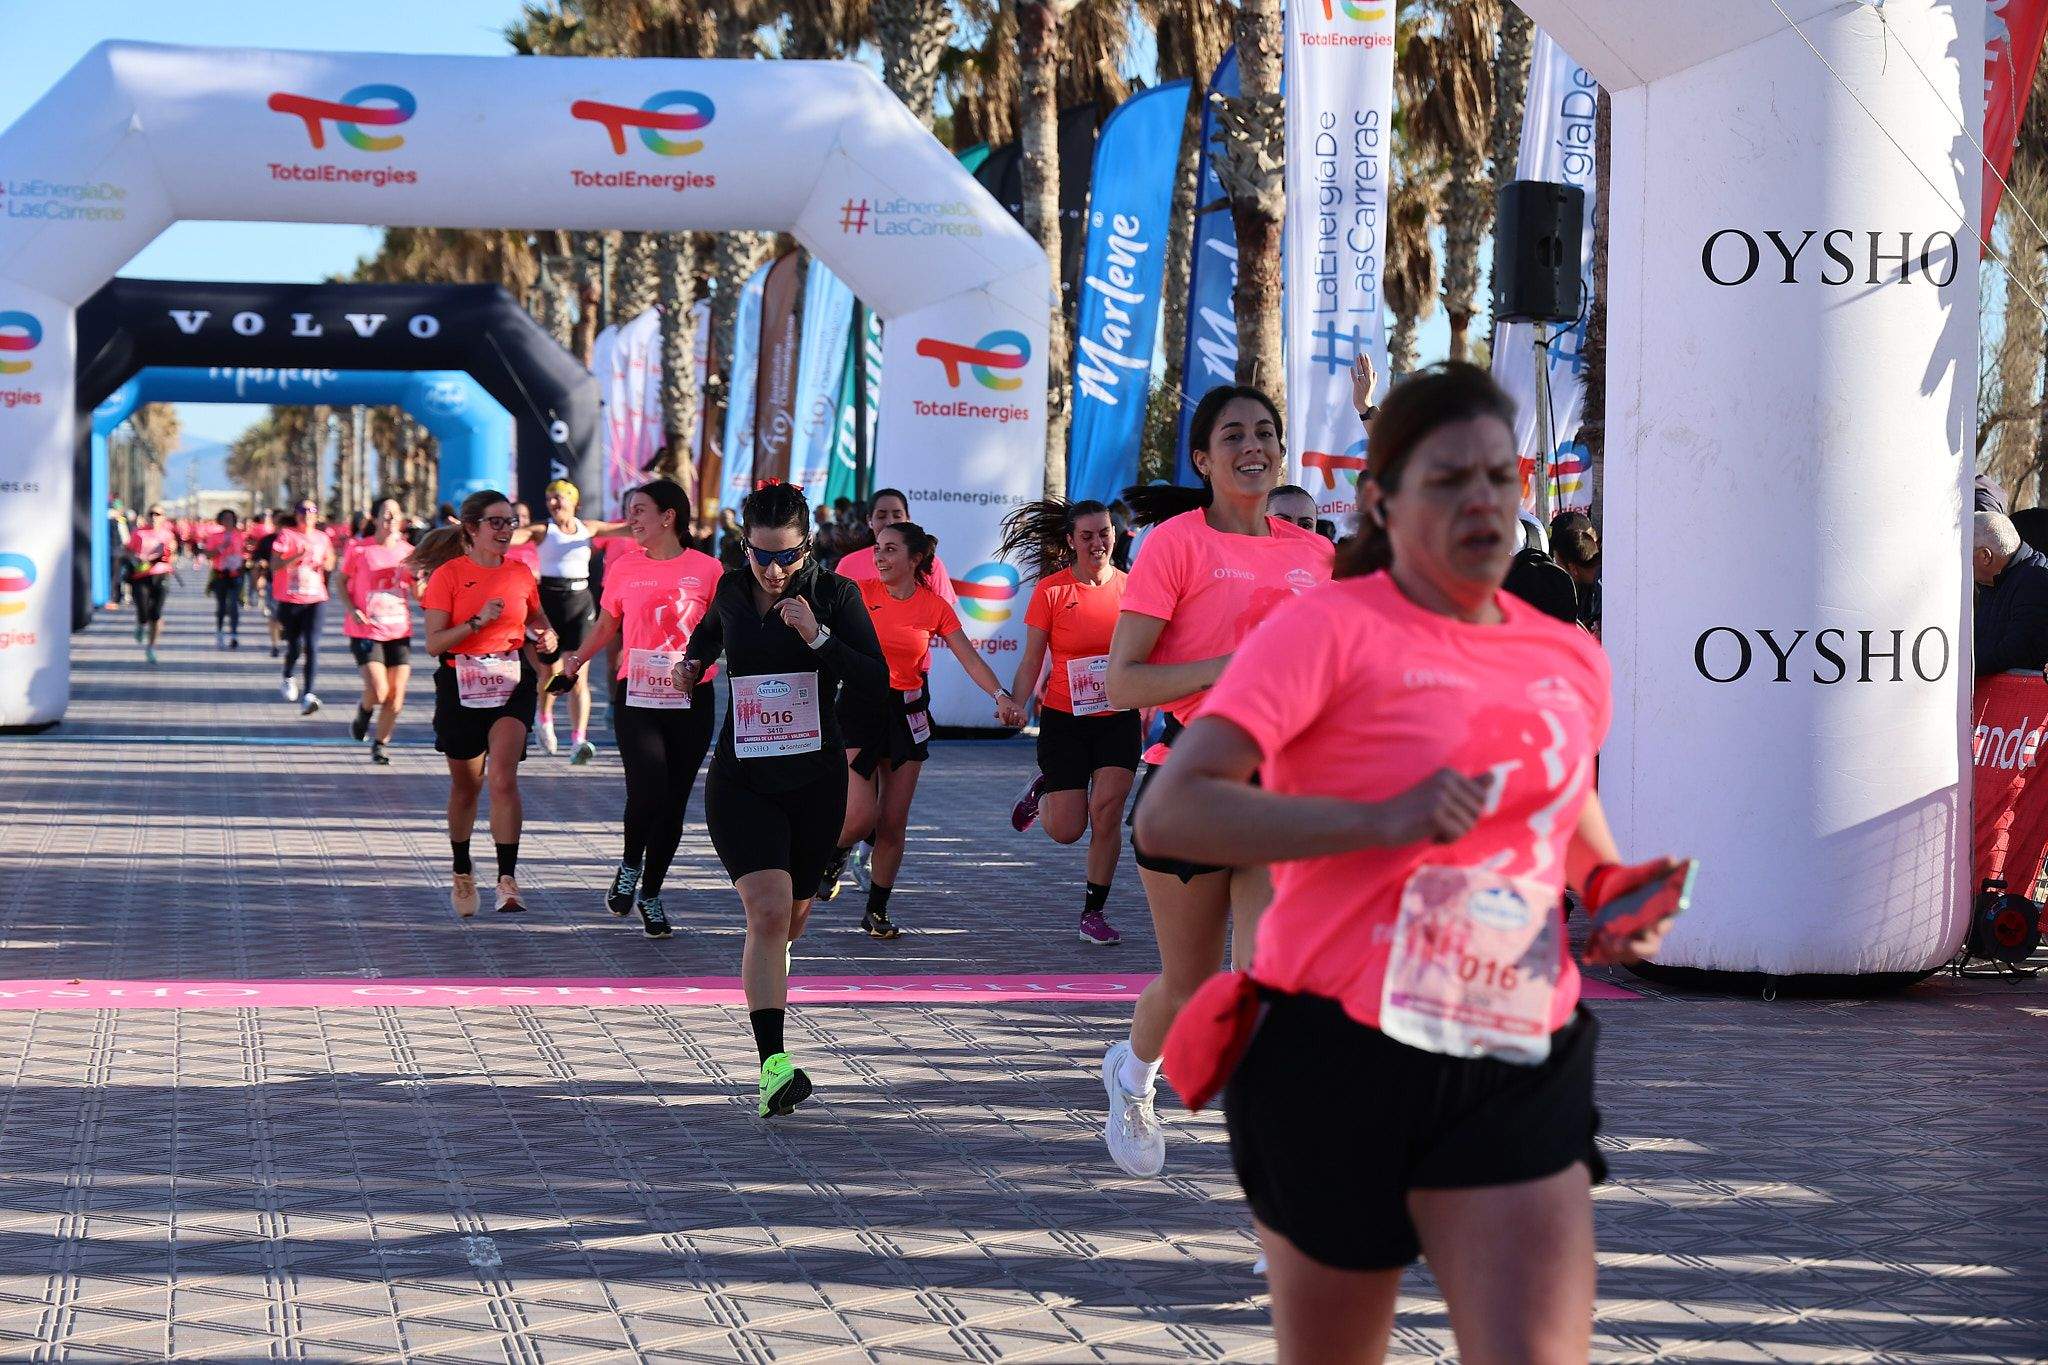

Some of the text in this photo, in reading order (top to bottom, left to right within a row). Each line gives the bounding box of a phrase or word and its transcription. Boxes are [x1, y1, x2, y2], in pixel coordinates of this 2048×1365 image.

[1300, 32, 1393, 49] TotalEnergies
[268, 163, 417, 188] TotalEnergies
[571, 170, 716, 192] TotalEnergies
[1347, 110, 1379, 313] LasCarreras
[1701, 229, 1959, 287] OYSHO
[1076, 213, 1150, 406] Marlene
[168, 310, 440, 339] VOLVO
[913, 400, 1029, 423] TotalEnergies
[908, 488, 1024, 506] totalenergies.es
[1694, 626, 1949, 684] OYSHO
[480, 675, 504, 686] 016
[648, 676, 672, 687] 016
[760, 710, 794, 725] 016
[1457, 955, 1519, 991] 016
[0, 988, 260, 999] YSHO
[352, 987, 702, 996] OYSHO
[791, 983, 1128, 993] OYSHO
